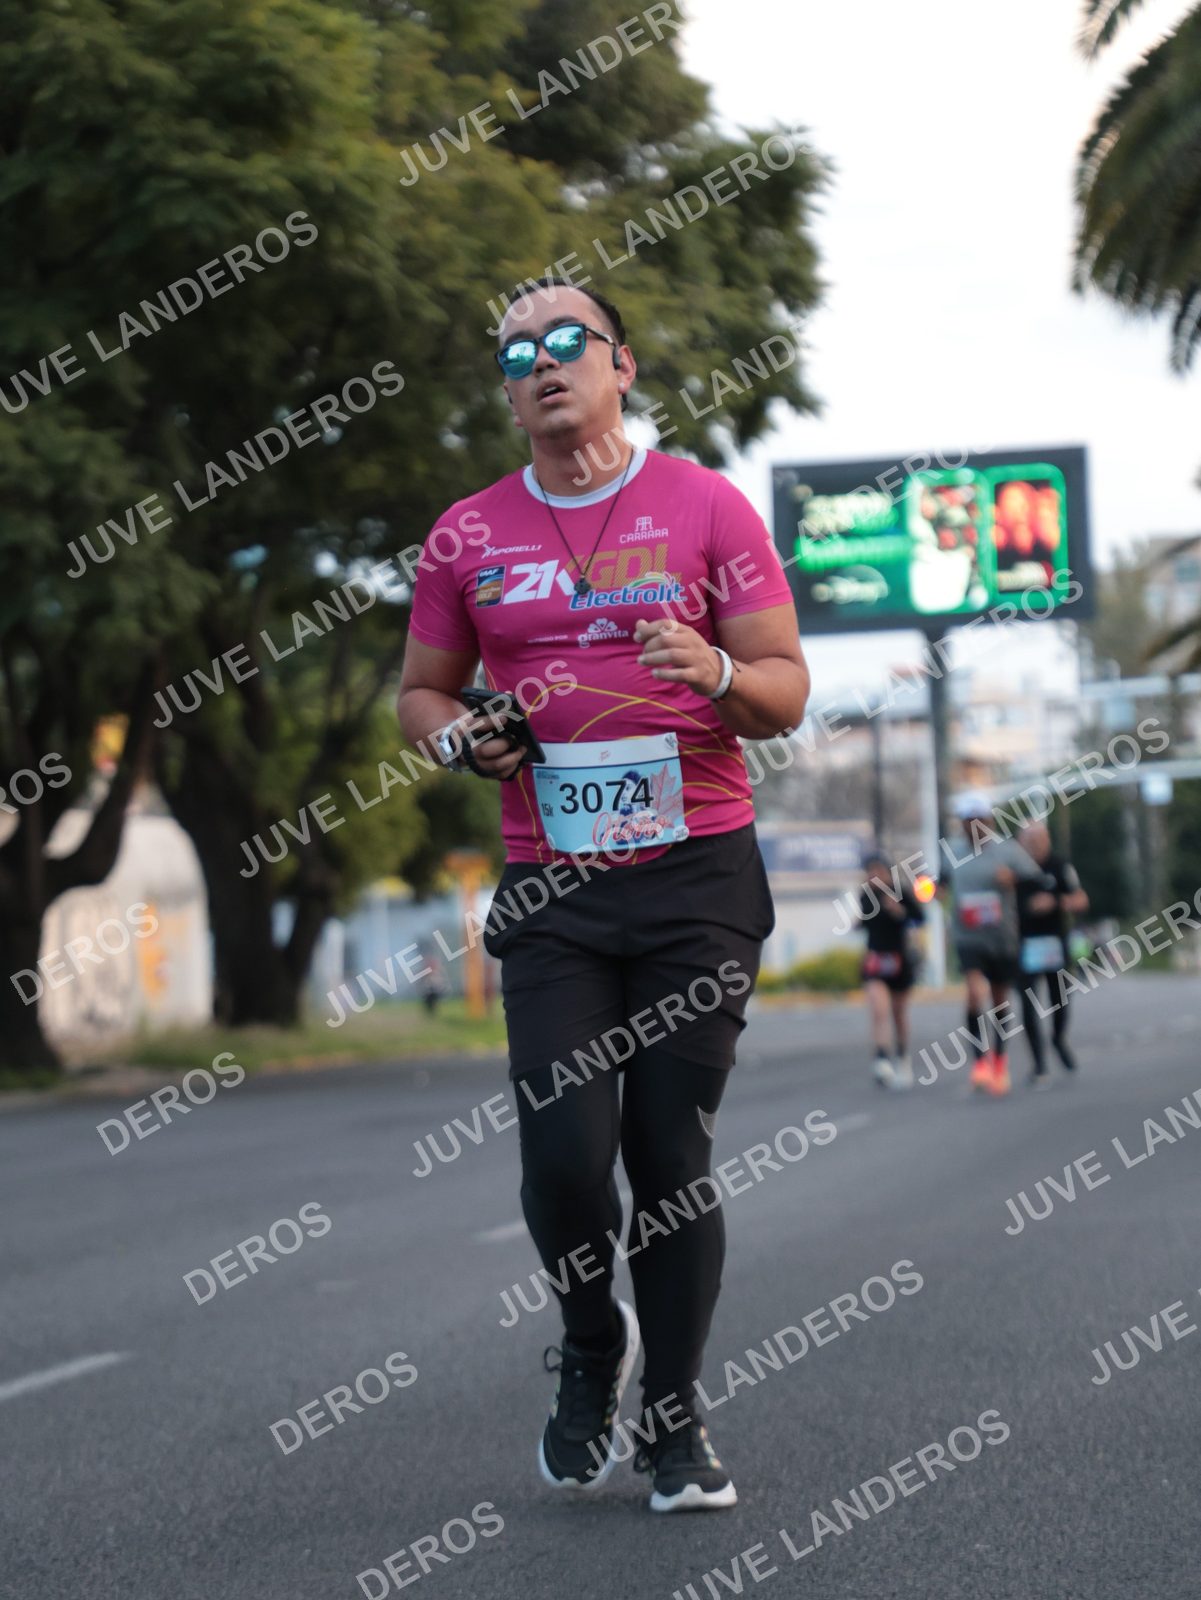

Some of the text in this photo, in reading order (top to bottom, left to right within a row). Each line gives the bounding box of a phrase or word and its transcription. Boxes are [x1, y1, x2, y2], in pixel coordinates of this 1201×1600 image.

[570, 583, 687, 611] Electrolit
[577, 630, 629, 648] granvita
[559, 777, 654, 814] 3074
